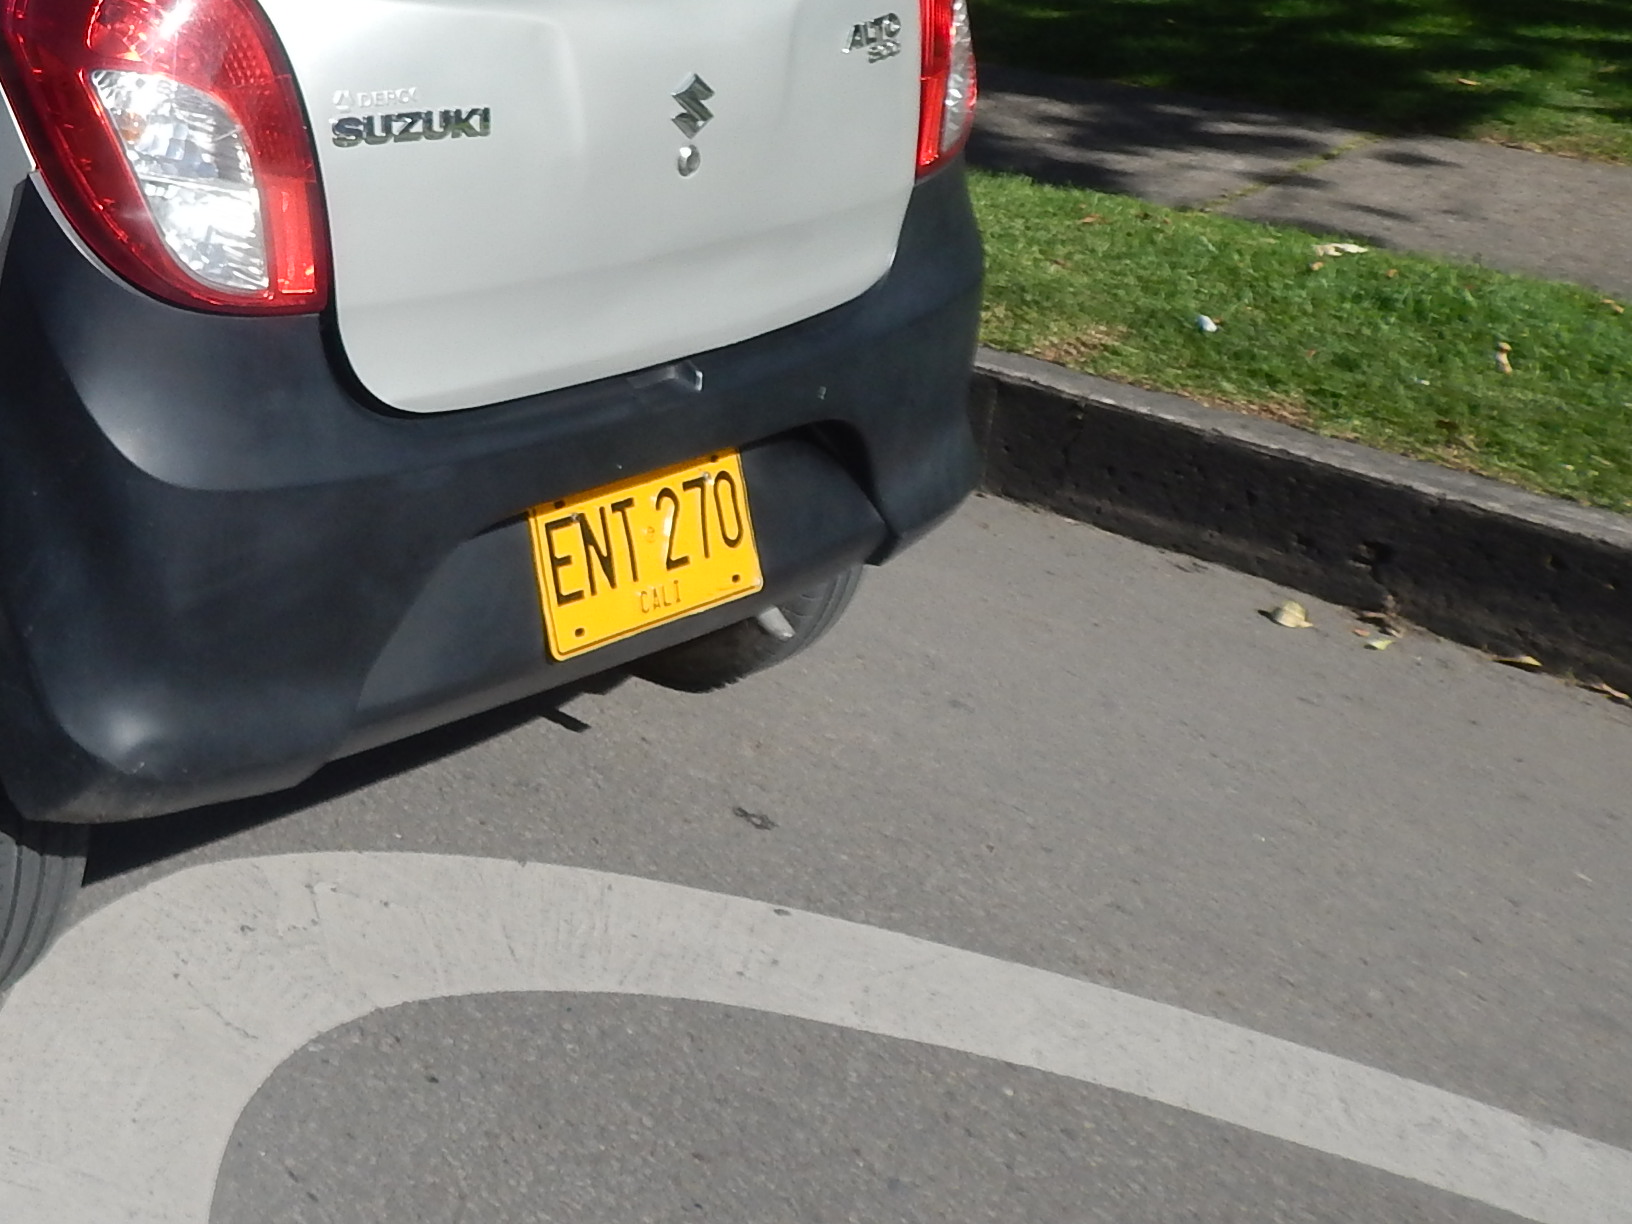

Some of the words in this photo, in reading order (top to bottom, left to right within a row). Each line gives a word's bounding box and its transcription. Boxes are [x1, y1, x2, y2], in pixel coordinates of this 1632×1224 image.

[330, 106, 491, 148] SUZUKI
[544, 497, 639, 607] ENT
[655, 470, 744, 572] 270
[639, 579, 683, 614] CALI
